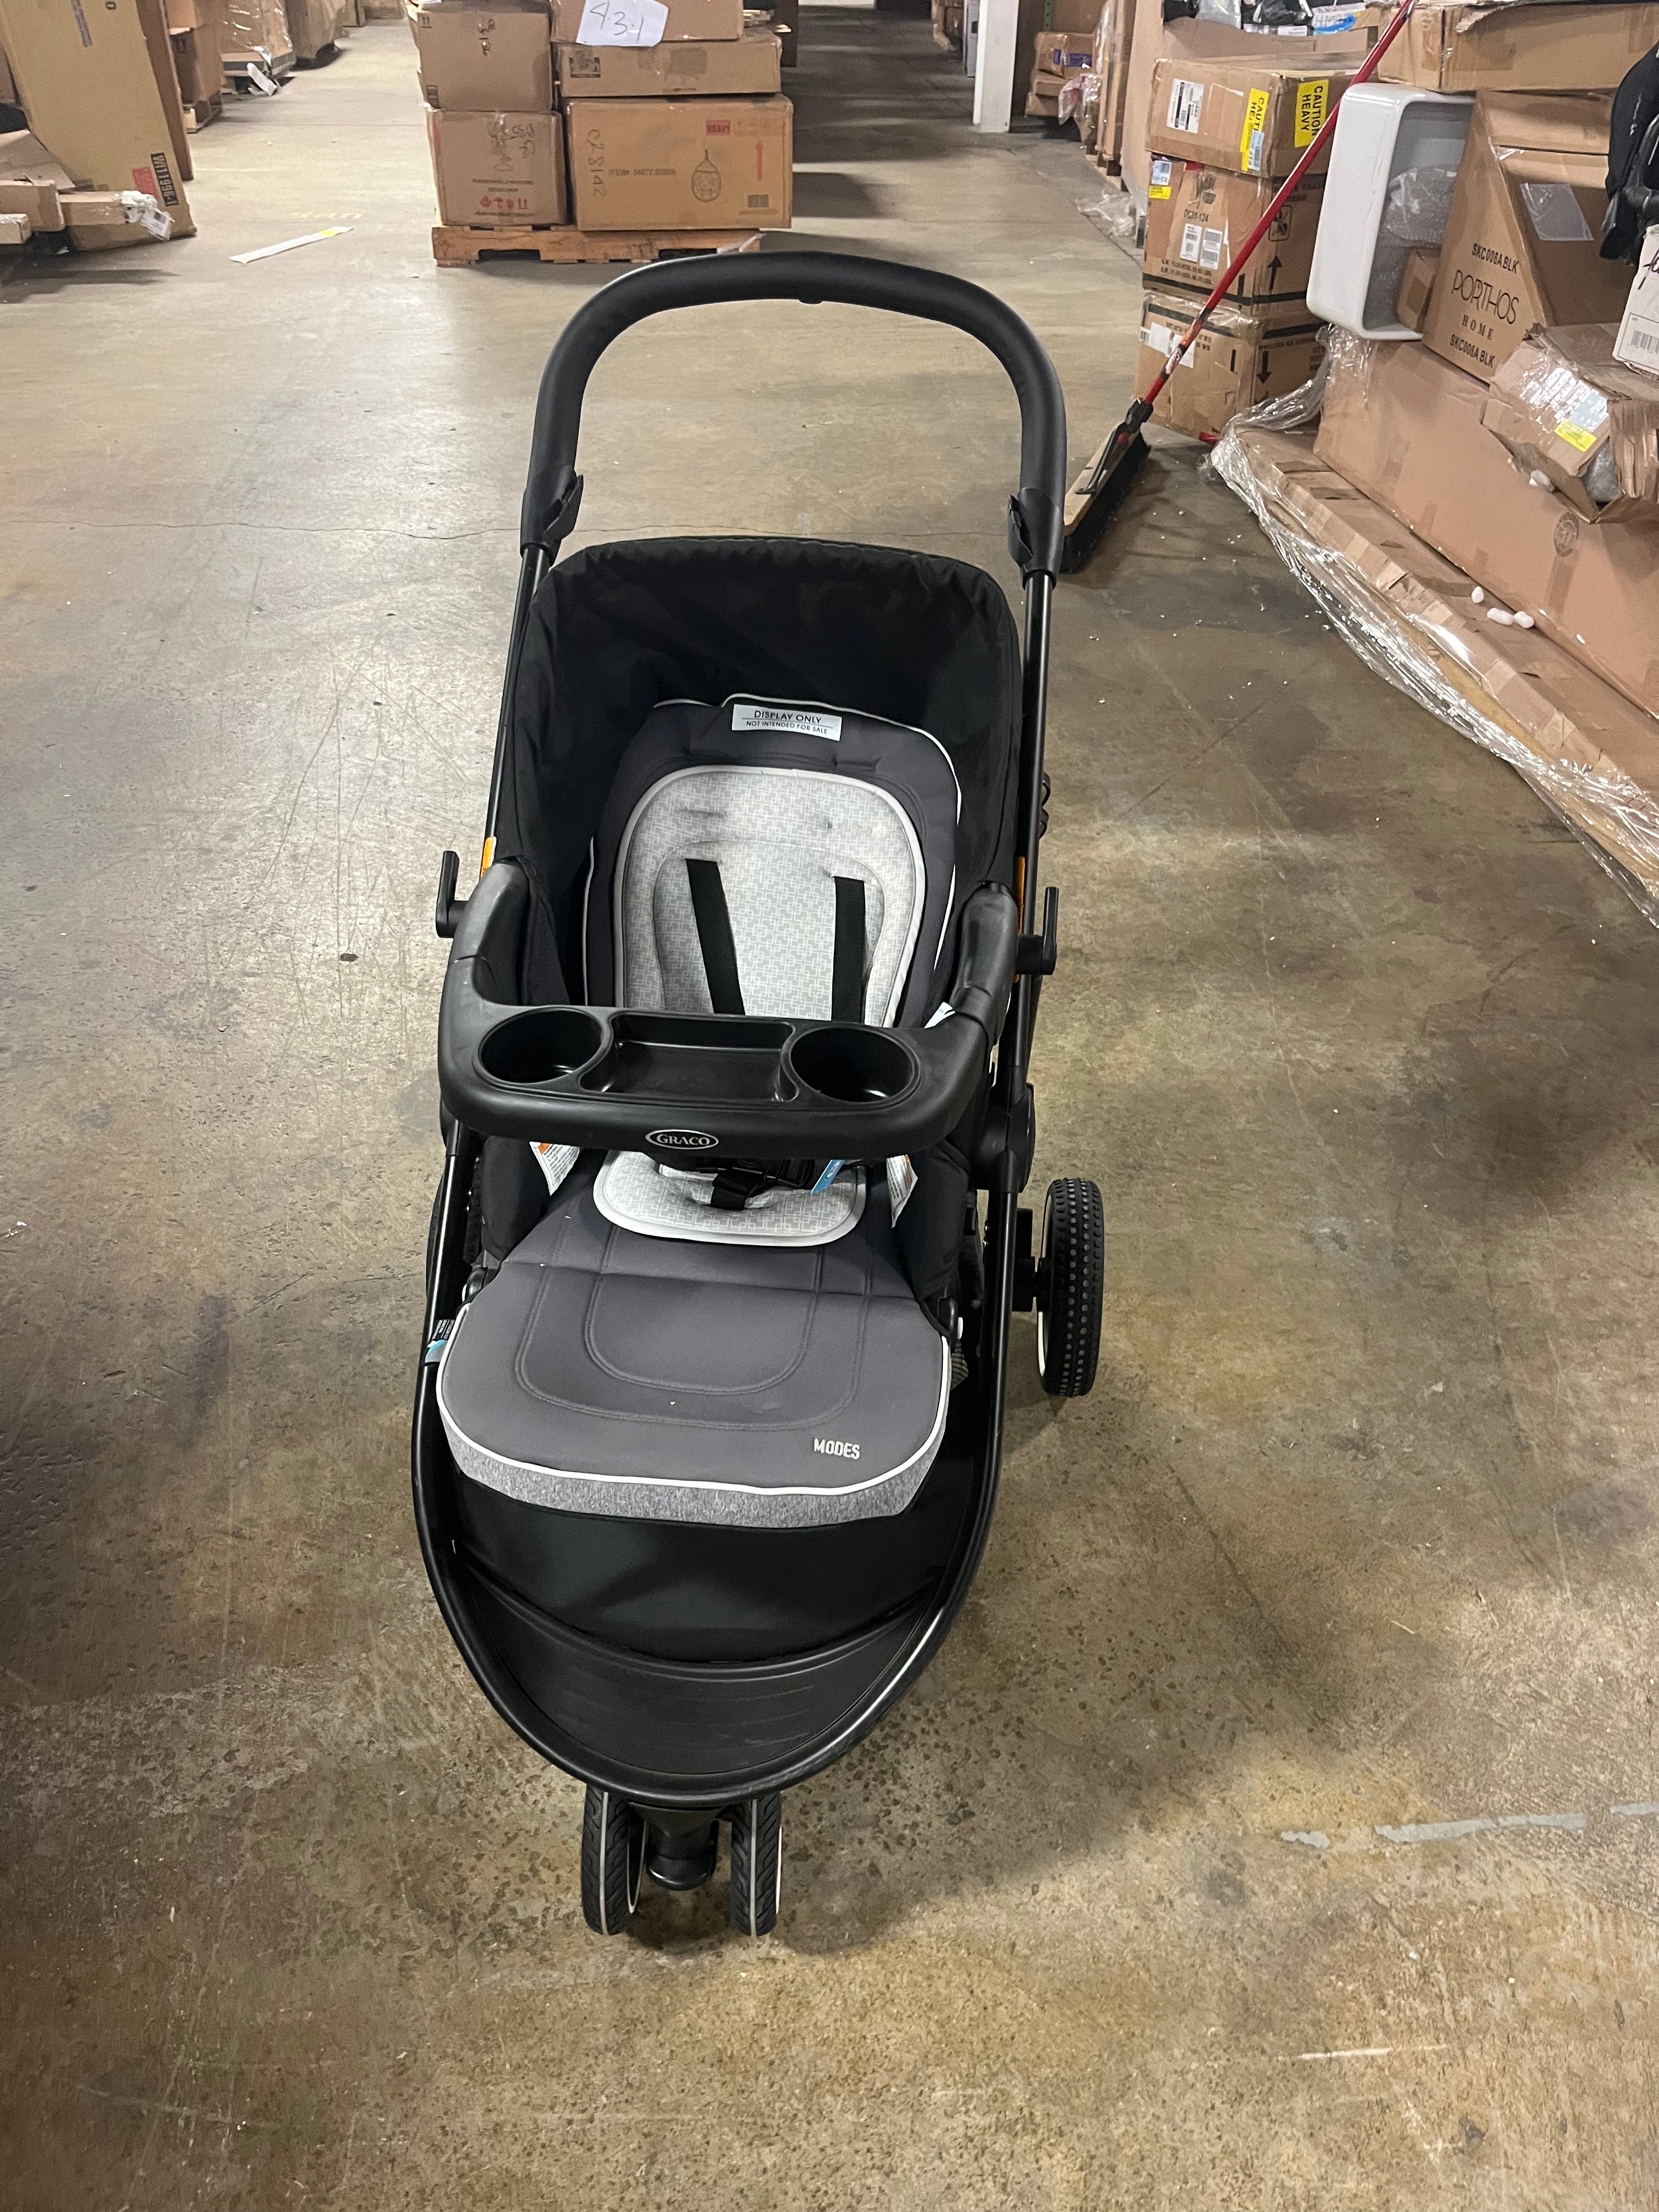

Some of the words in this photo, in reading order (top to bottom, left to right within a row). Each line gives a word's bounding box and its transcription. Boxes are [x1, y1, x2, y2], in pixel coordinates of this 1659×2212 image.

[1253, 97, 1265, 131] CAUTI
[1301, 94, 1312, 131] HEAVY
[1311, 86, 1323, 136] CAUTION
[1451, 269, 1519, 324] PORTHOS
[1462, 314, 1494, 341] HOME
[754, 710, 793, 721] DISPLAY
[795, 714, 822, 724] ONLY
[812, 726, 827, 735] SALE
[656, 1133, 710, 1146] GRACO
[814, 1438, 860, 1460] MODES
